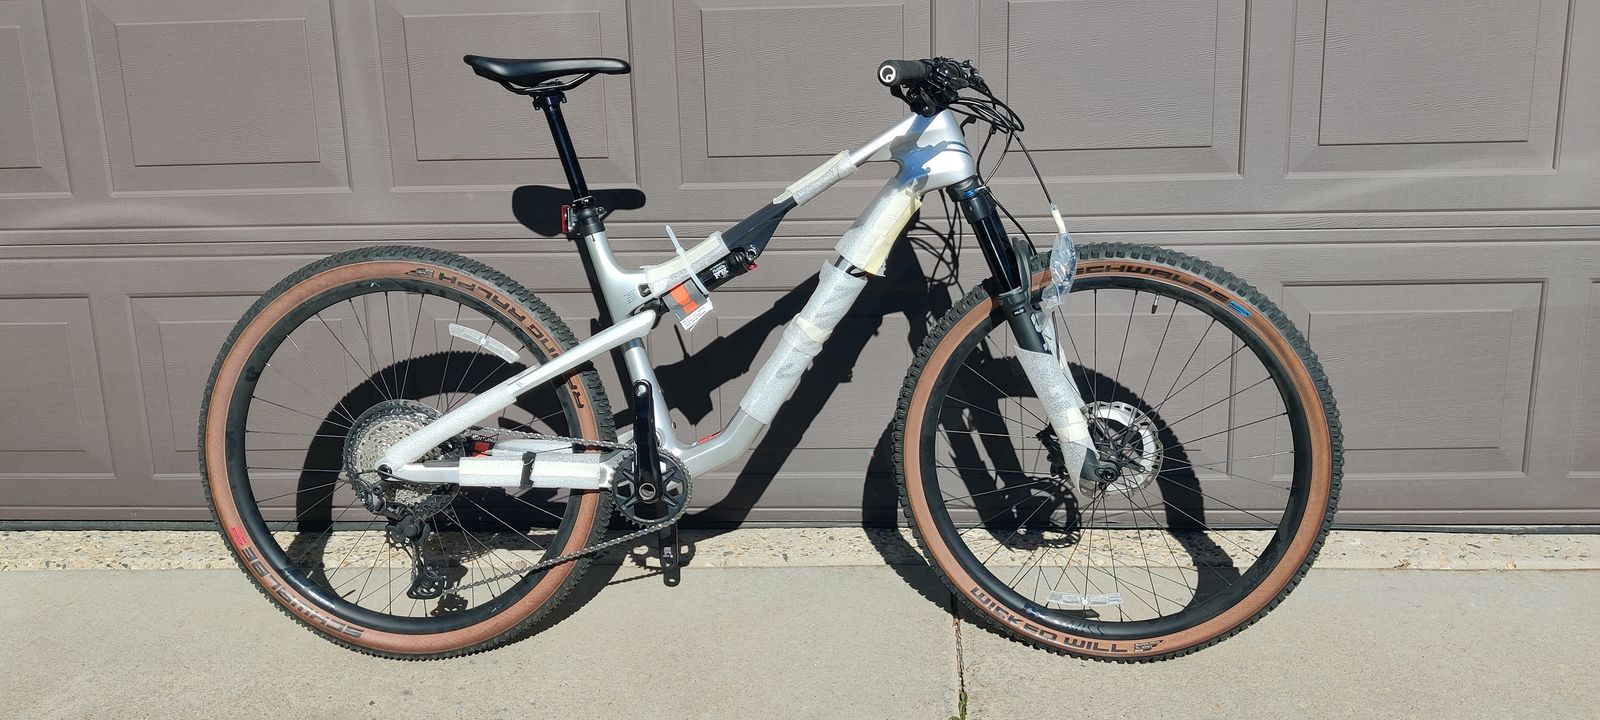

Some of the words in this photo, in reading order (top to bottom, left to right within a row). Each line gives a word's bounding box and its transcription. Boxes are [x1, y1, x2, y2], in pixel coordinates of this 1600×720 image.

[438, 272, 527, 323] RALPH
[528, 323, 585, 409] RAING
[241, 546, 364, 638] SCHWALBE
[970, 586, 1057, 642] WICKED
[1063, 636, 1128, 653] WILL
